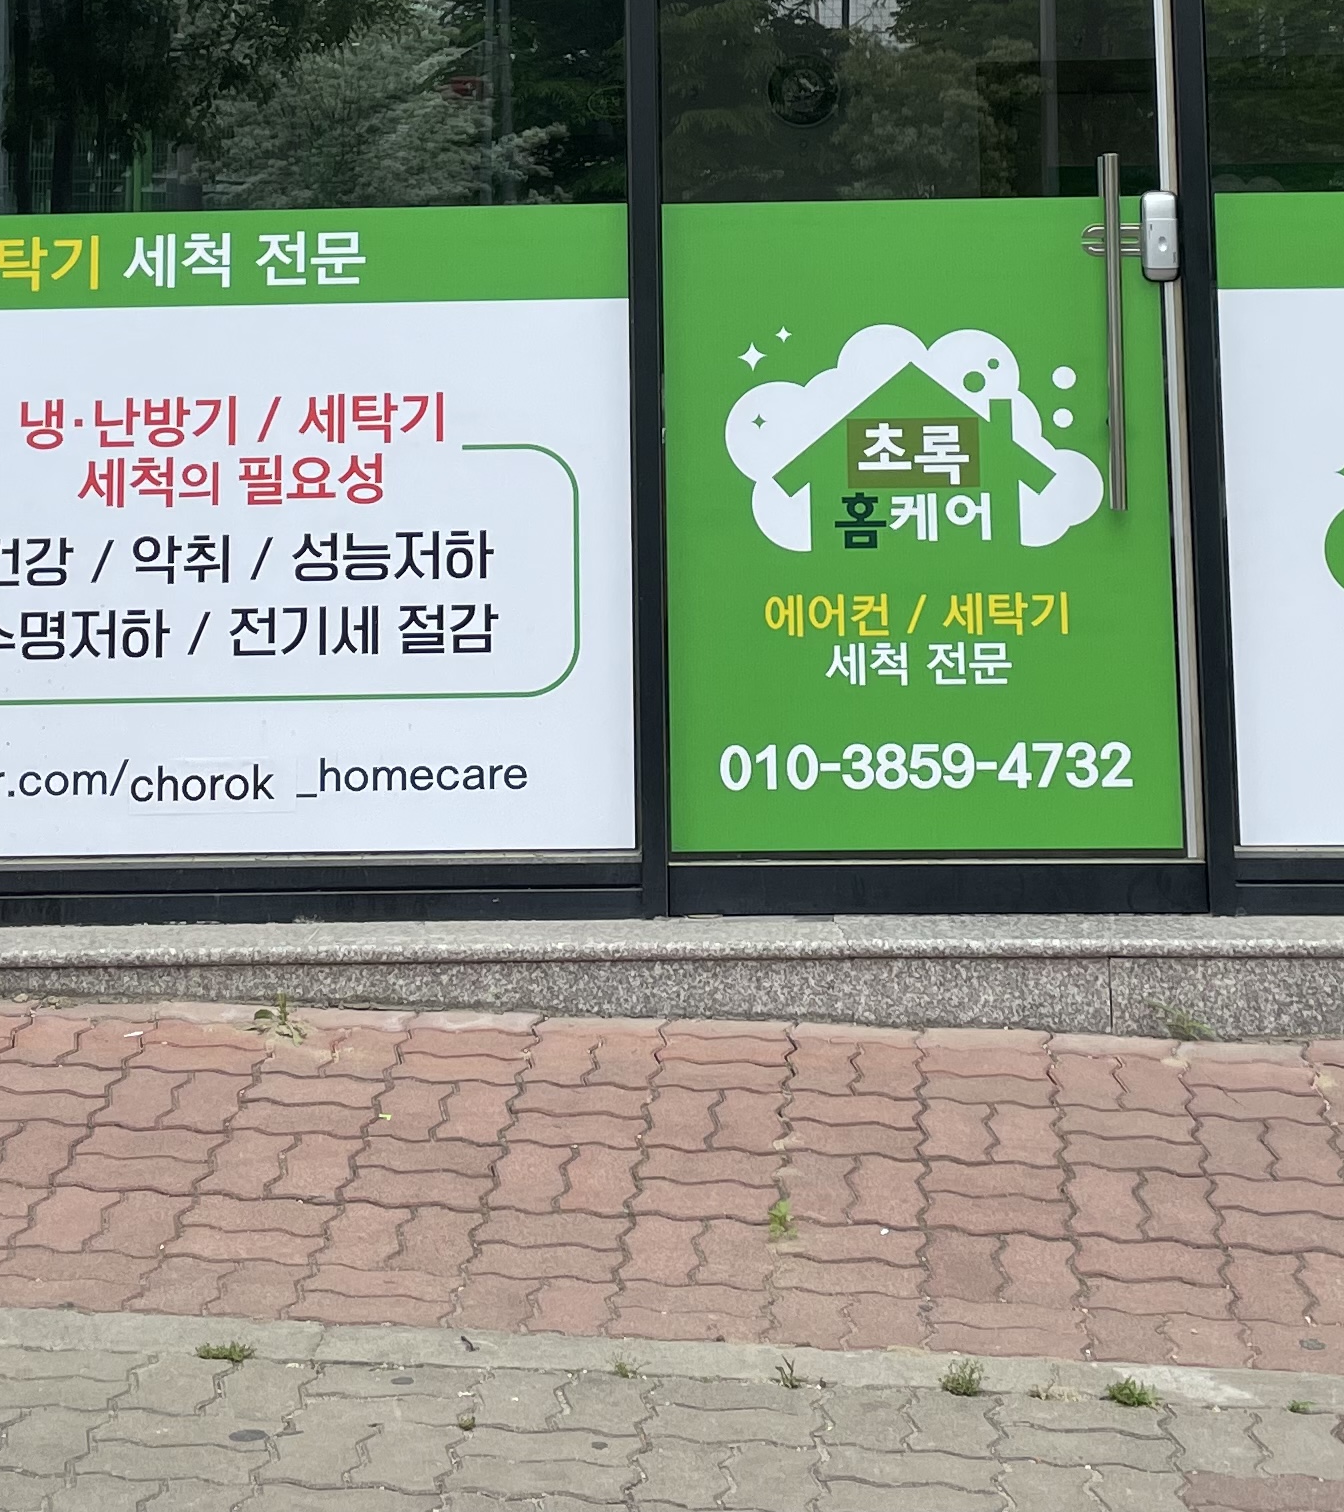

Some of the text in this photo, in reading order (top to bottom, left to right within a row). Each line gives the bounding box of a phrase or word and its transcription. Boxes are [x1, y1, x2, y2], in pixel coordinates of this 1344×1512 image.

[124, 232, 231, 288] 세척
[256, 231, 366, 285] 전문
[257, 396, 281, 442] /
[299, 392, 443, 443] 세탁기
[857, 422, 970, 485] 초록
[78, 453, 383, 508] 세척의 필요성
[835, 492, 992, 549] 홈케어
[91, 540, 114, 583] /
[133, 535, 229, 584] 악취
[250, 537, 273, 580] /
[292, 530, 494, 581] 성능저하
[188, 612, 210, 655] /
[230, 605, 378, 656] 전기세
[399, 604, 499, 654] 절감
[765, 592, 1068, 637] 에어컨 / 세탁기
[826, 642, 1012, 686] 세척 전문
[719, 741, 1134, 791] 010-3859-4732
